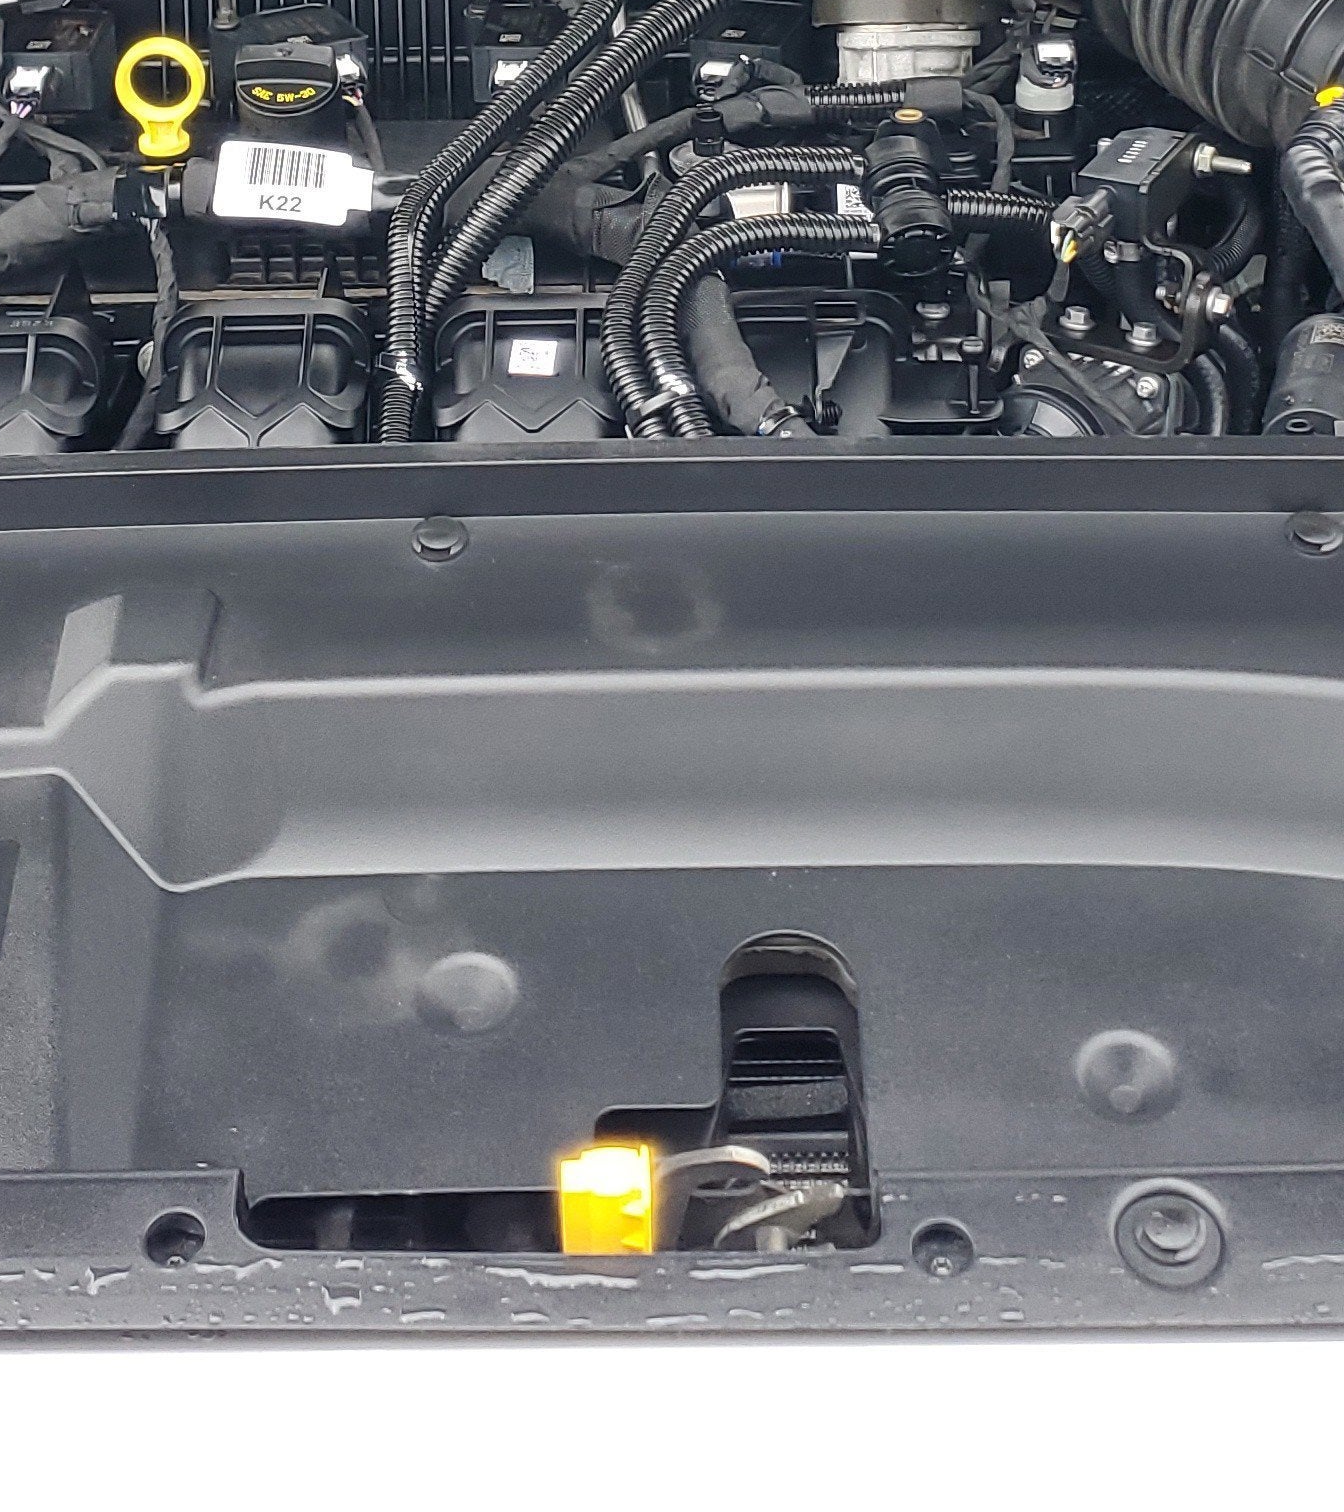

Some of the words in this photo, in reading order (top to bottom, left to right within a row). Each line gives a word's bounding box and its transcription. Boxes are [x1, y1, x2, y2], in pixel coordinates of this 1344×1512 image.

[251, 86, 274, 101] SAE
[276, 86, 316, 103] 5W-30
[259, 194, 302, 213] K22
